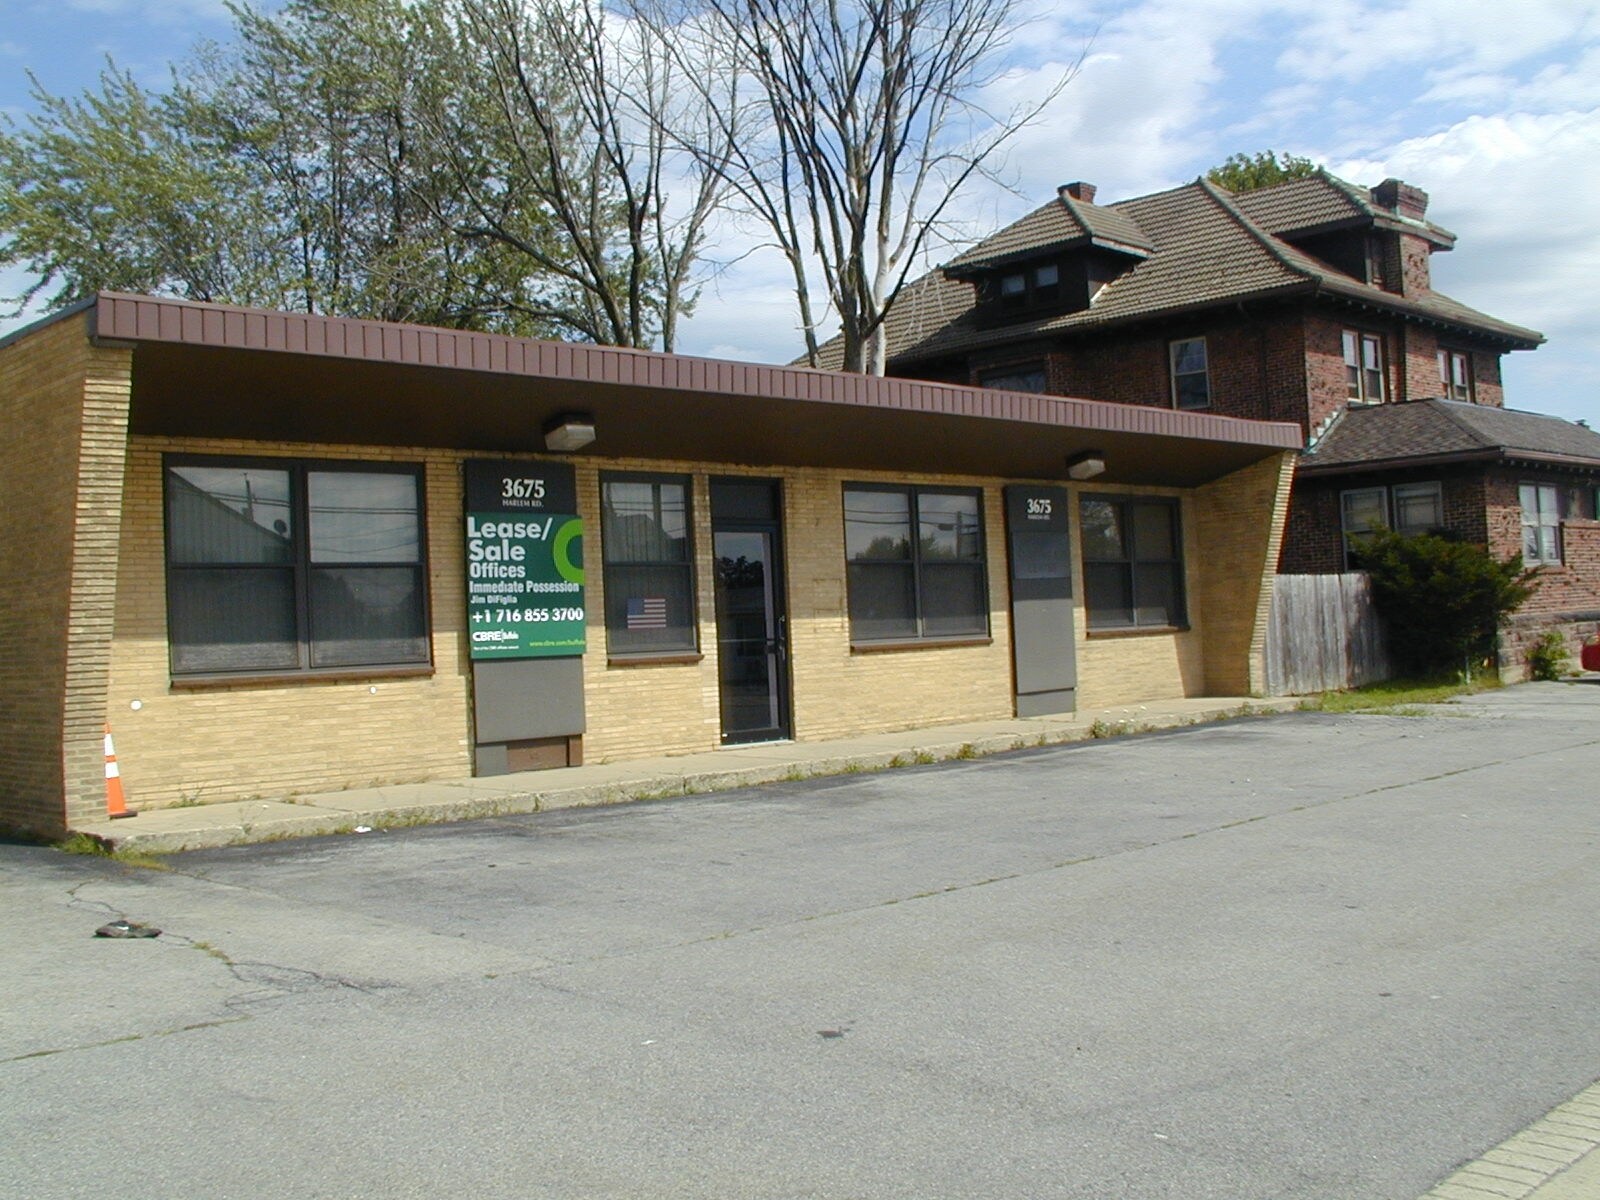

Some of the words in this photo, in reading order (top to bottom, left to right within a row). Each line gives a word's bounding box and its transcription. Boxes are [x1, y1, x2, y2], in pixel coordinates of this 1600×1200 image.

[502, 478, 545, 498] 3675
[502, 499, 530, 507] HARLEM
[531, 500, 544, 508] RD.
[1027, 498, 1051, 514] 3675
[467, 516, 553, 541] Lease/
[469, 539, 526, 561] Sale
[469, 562, 526, 578] Offices
[469, 581, 524, 593] Immediate
[526, 580, 579, 593] Possession
[470, 594, 486, 604] Jim
[472, 609, 491, 623] +1
[496, 609, 521, 623] 716
[524, 608, 549, 622] 855
[552, 607, 584, 622] 3700
[472, 631, 502, 641] CBRE
